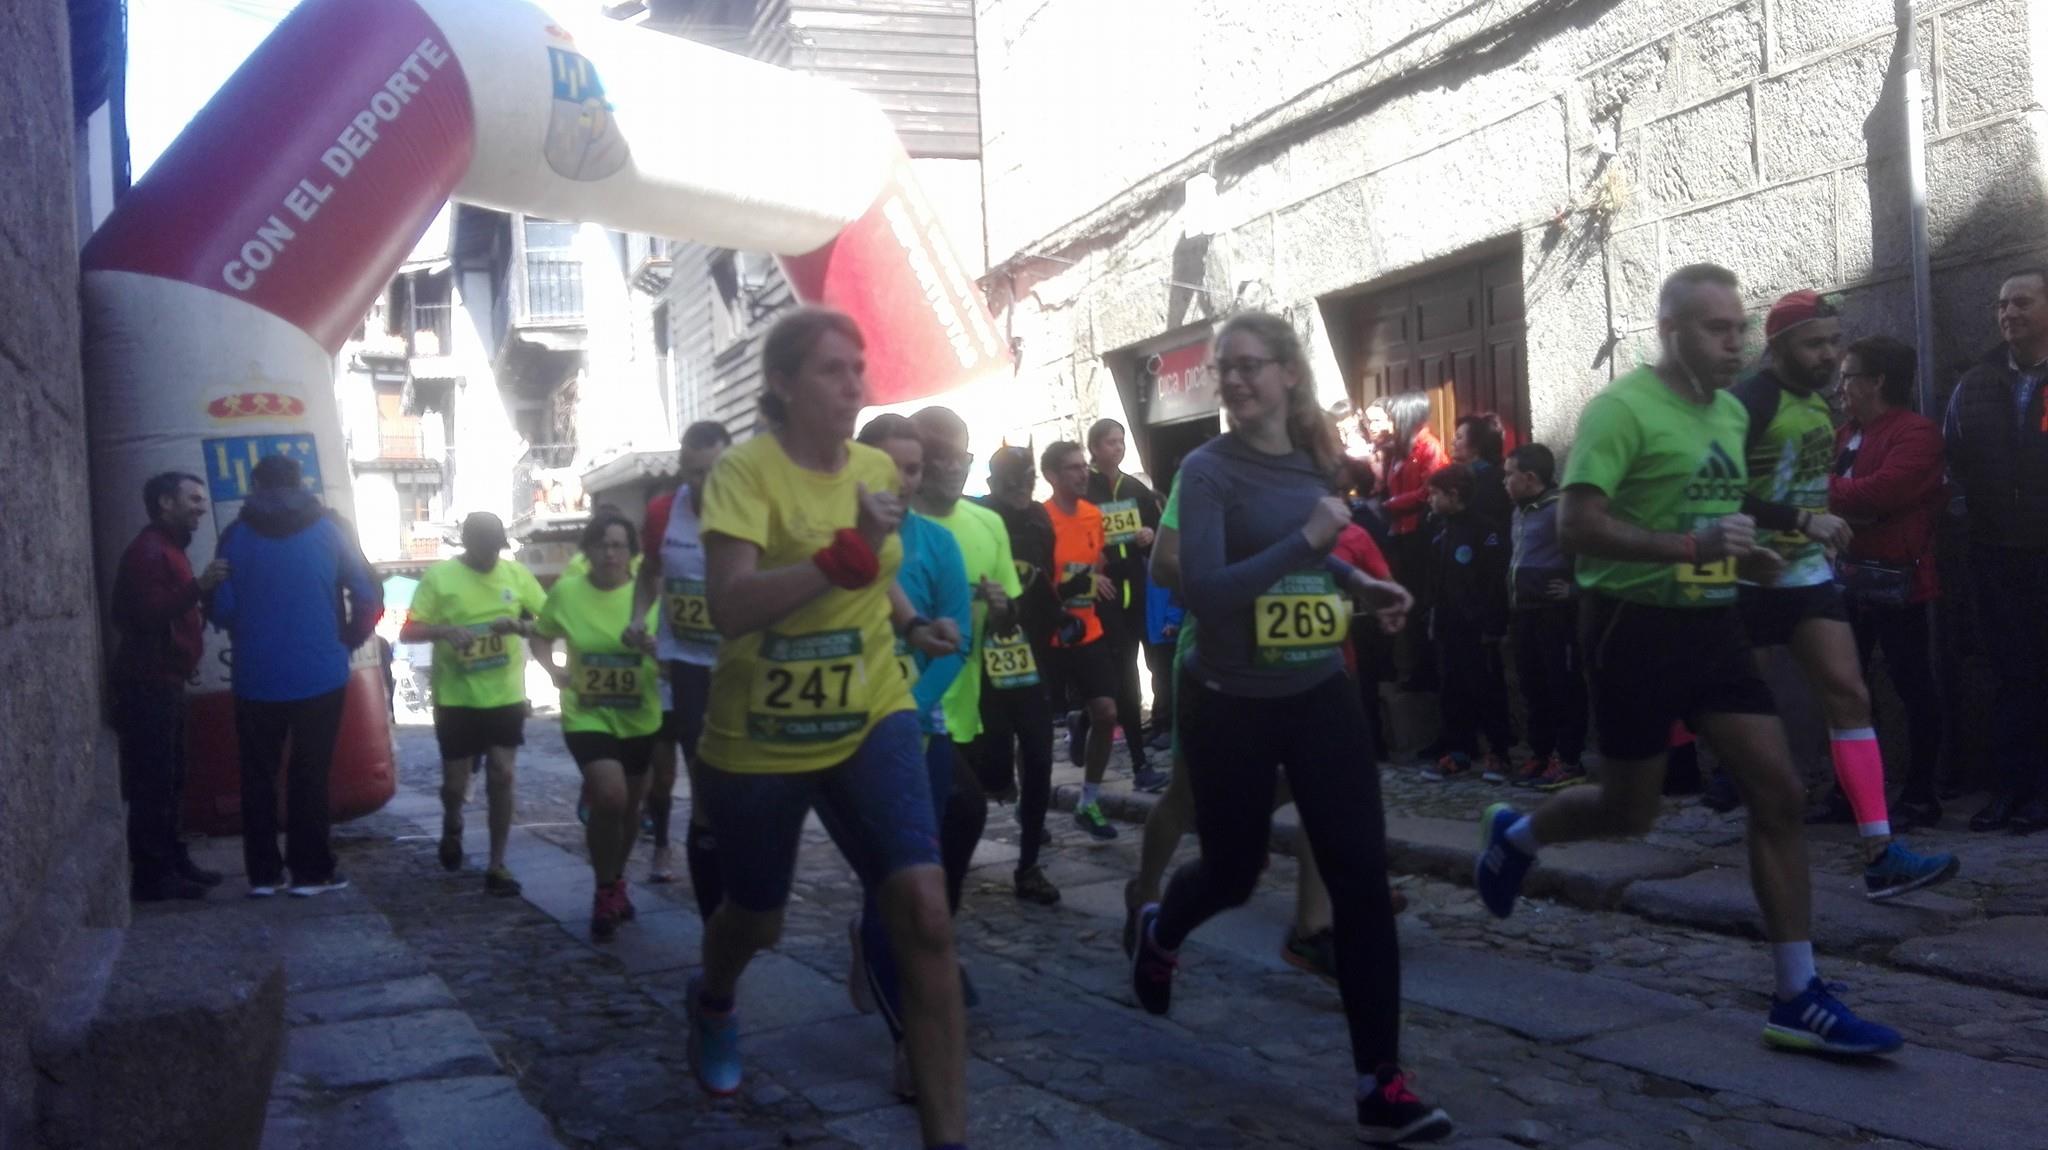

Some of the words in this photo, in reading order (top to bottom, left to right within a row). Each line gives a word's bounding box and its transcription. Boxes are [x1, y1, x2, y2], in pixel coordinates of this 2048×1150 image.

[222, 215, 296, 291] CON
[283, 178, 335, 222] EL
[320, 38, 450, 178] DEPORTE
[1102, 512, 1136, 532] 254
[672, 597, 704, 625] 22
[1266, 601, 1336, 639] 269
[989, 648, 1030, 673] 233
[586, 670, 636, 692] 249
[764, 663, 853, 709] 247
